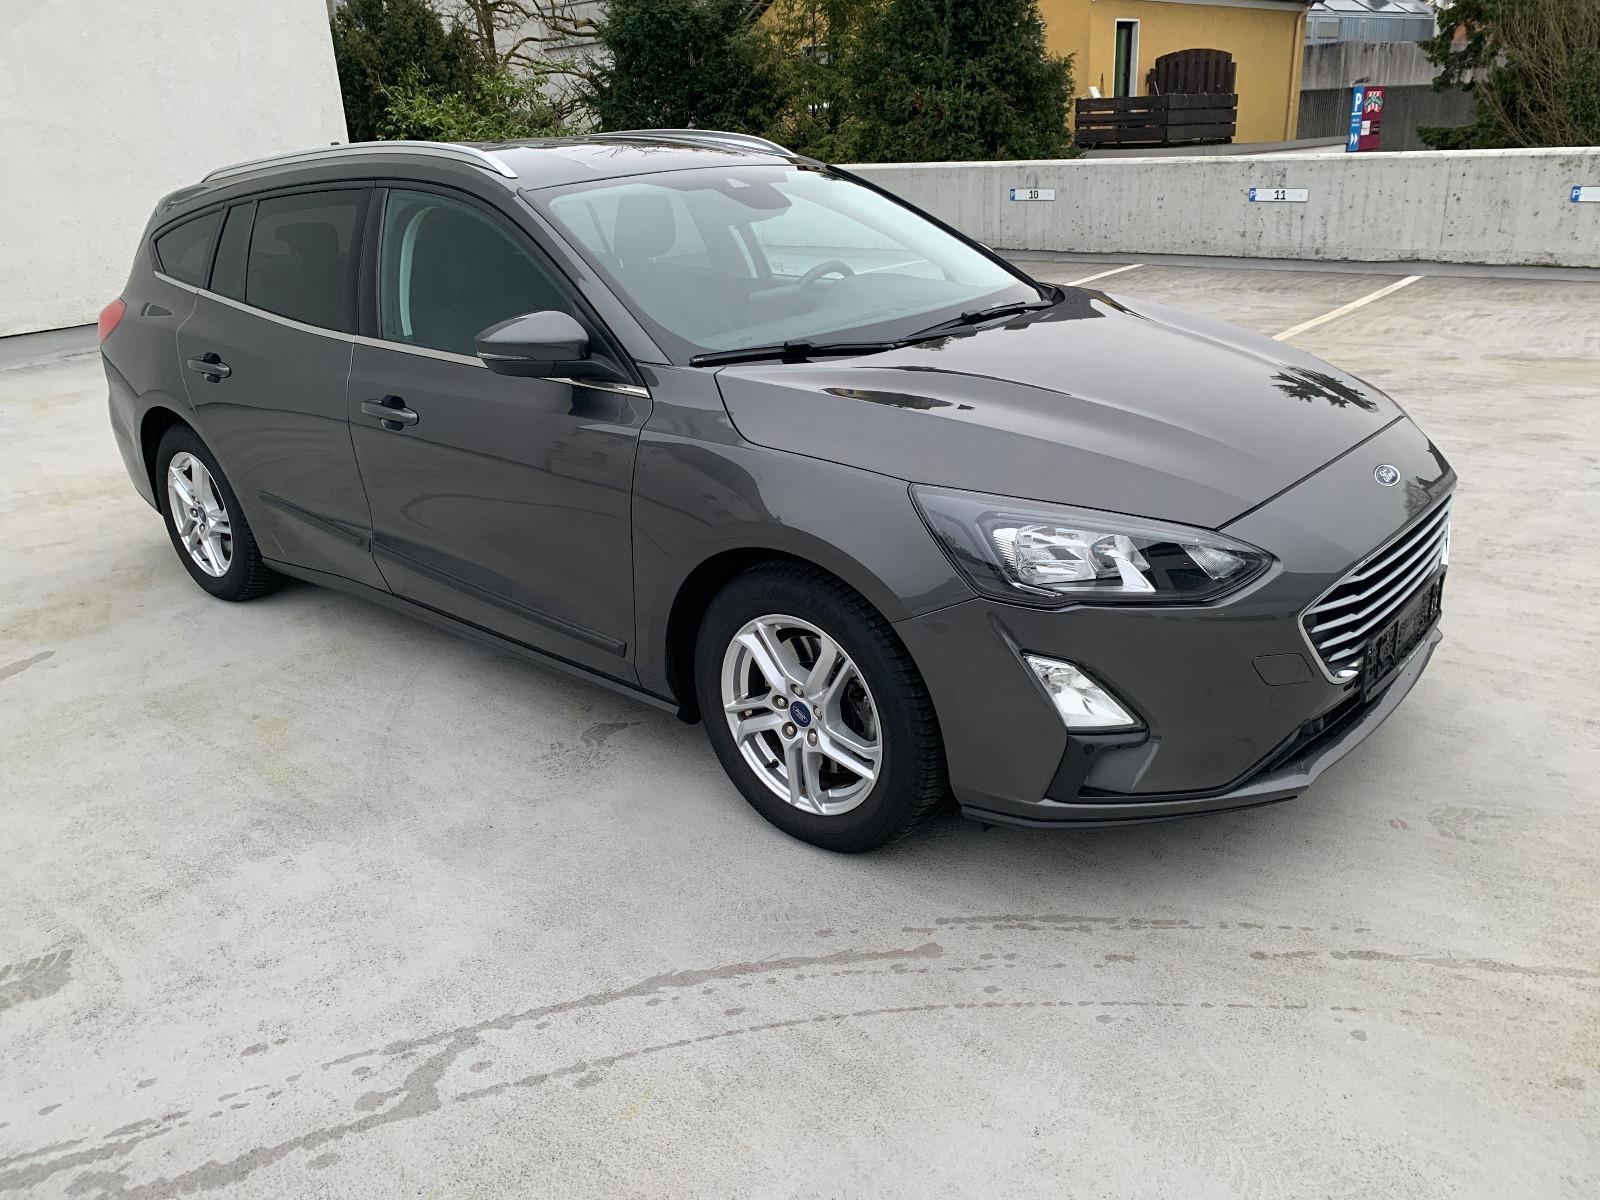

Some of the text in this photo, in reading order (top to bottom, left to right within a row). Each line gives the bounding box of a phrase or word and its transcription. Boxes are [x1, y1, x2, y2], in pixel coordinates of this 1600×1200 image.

[1355, 93, 1362, 112] P
[1029, 190, 1038, 199] 10
[1250, 190, 1286, 200] P 11
[1573, 189, 1580, 198] P
